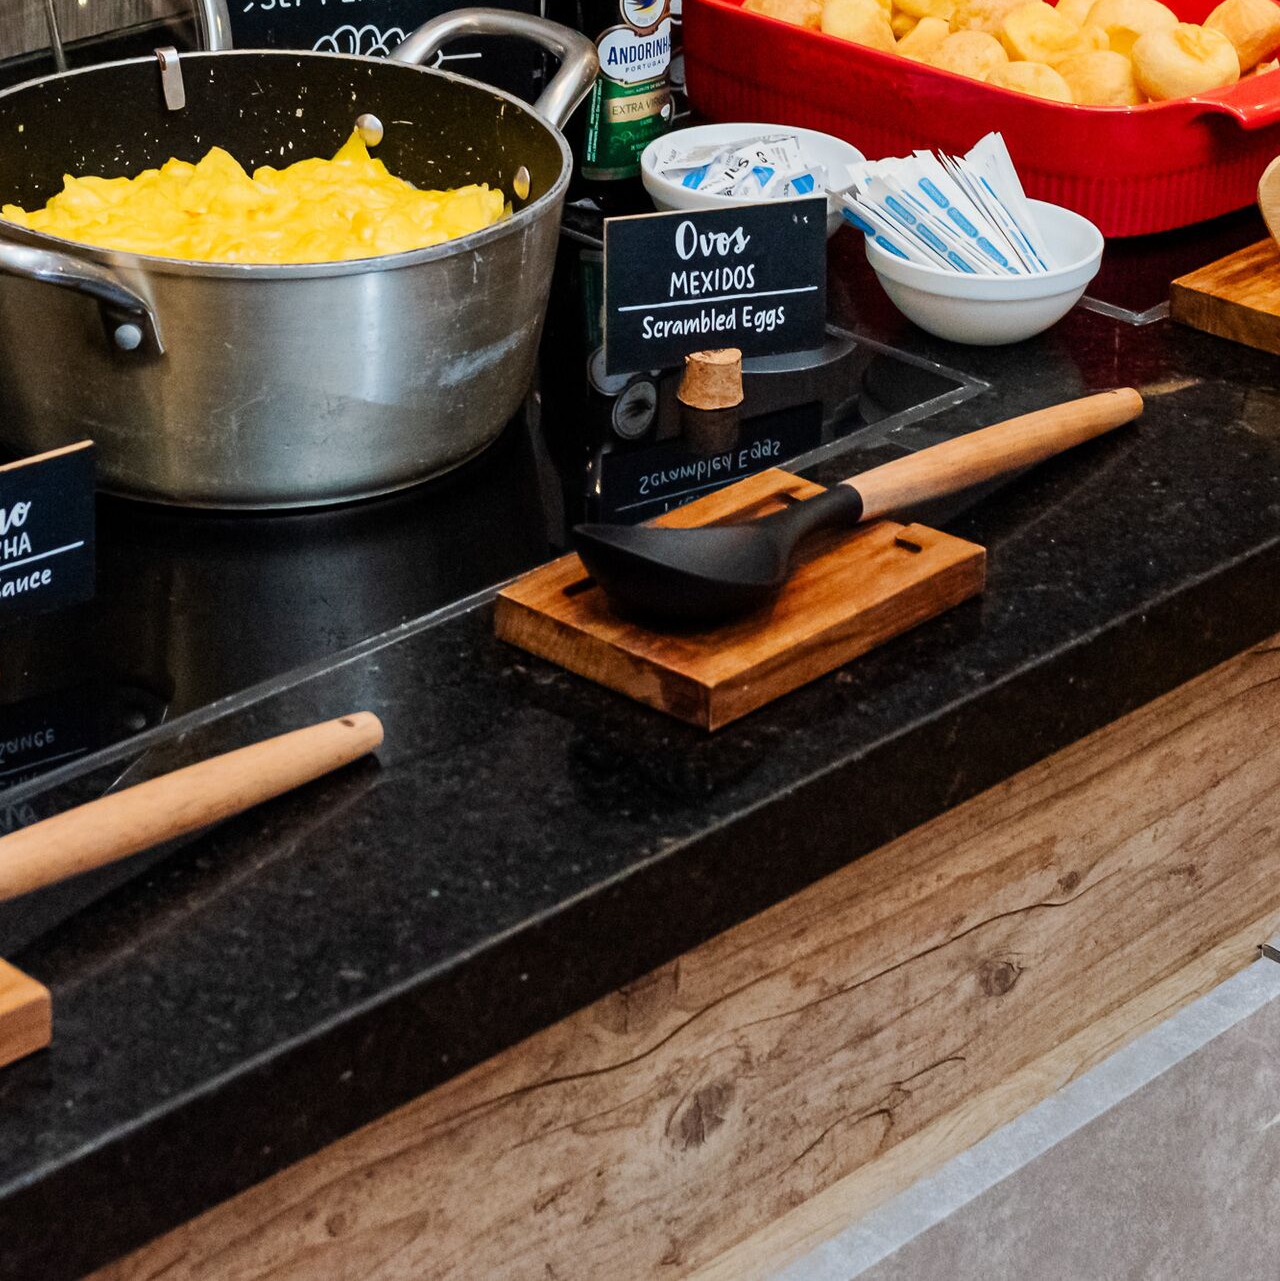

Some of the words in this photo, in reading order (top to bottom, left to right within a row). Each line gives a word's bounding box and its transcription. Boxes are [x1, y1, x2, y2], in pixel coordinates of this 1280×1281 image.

[625, 58, 665, 73] PORTUGAL
[612, 102, 644, 116] EXTRA
[674, 219, 751, 261] Ovos
[669, 263, 756, 297] MEXIDOS
[641, 305, 737, 340] Scrambled
[742, 304, 785, 335] Eggs
